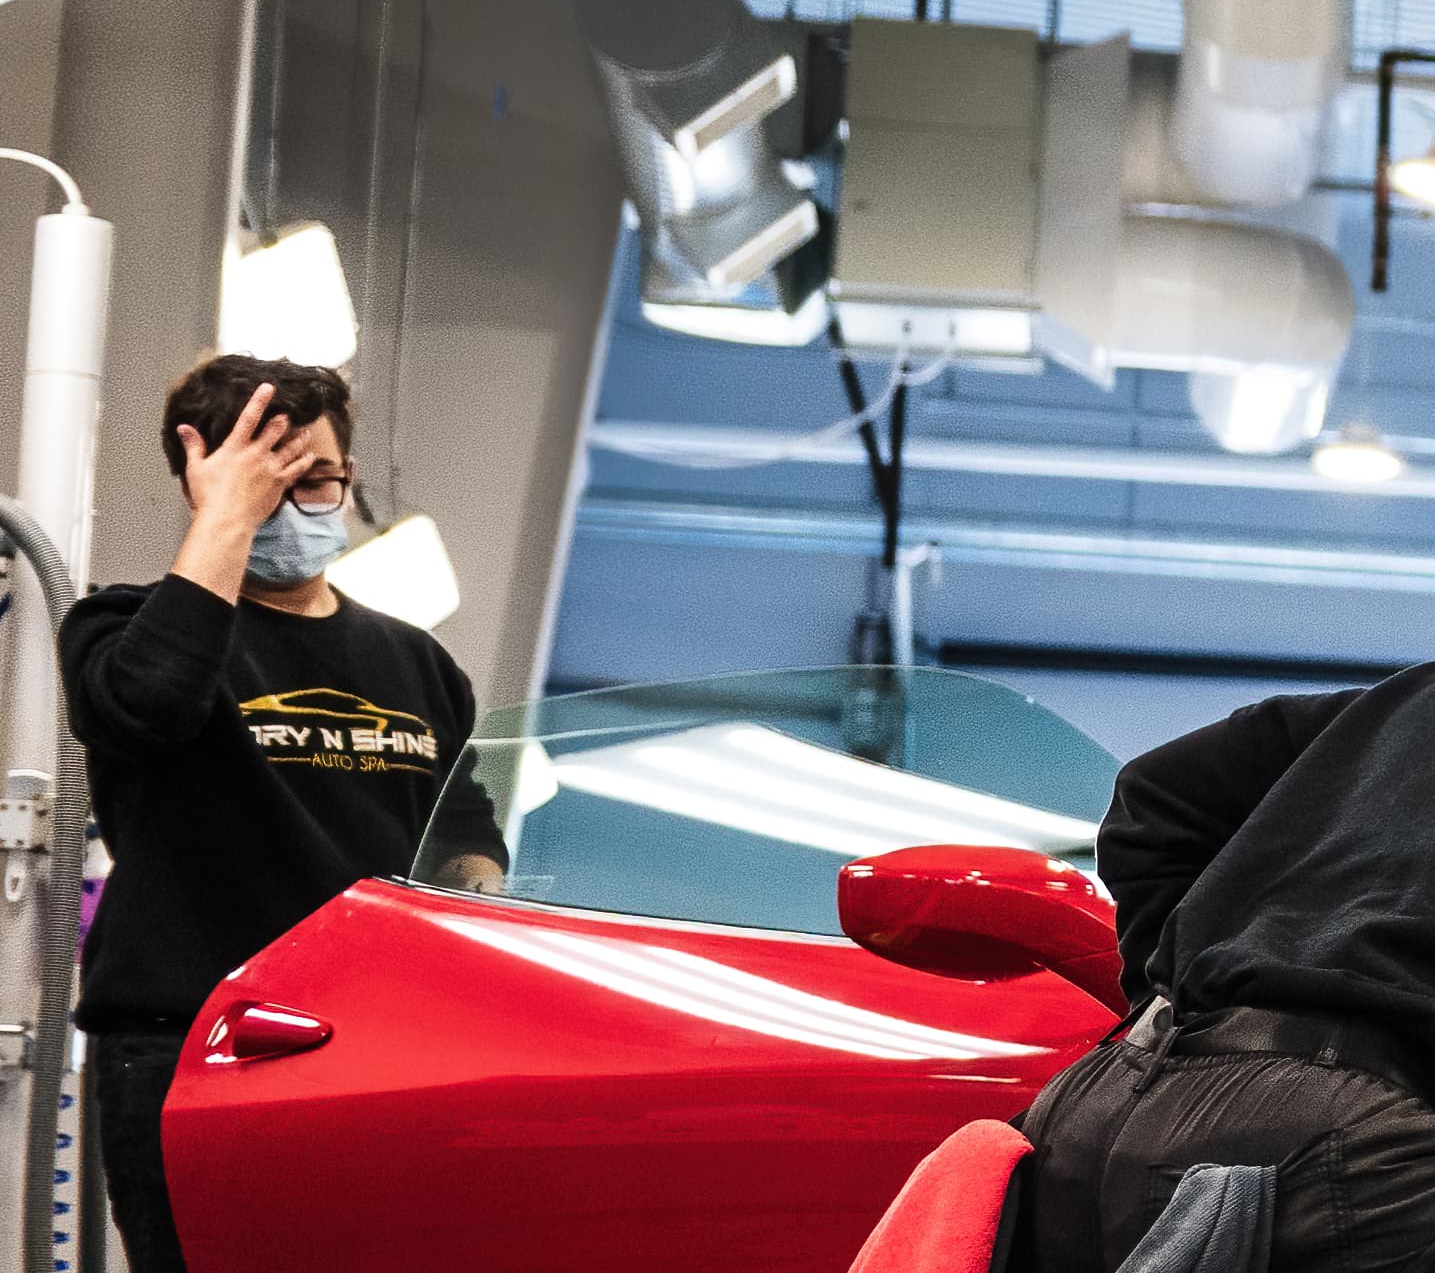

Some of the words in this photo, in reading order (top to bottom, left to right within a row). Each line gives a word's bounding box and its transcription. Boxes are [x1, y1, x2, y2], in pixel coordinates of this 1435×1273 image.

[350, 728, 438, 760] SHINE
[312, 753, 353, 770] AUTO
[359, 755, 387, 772] SPA
